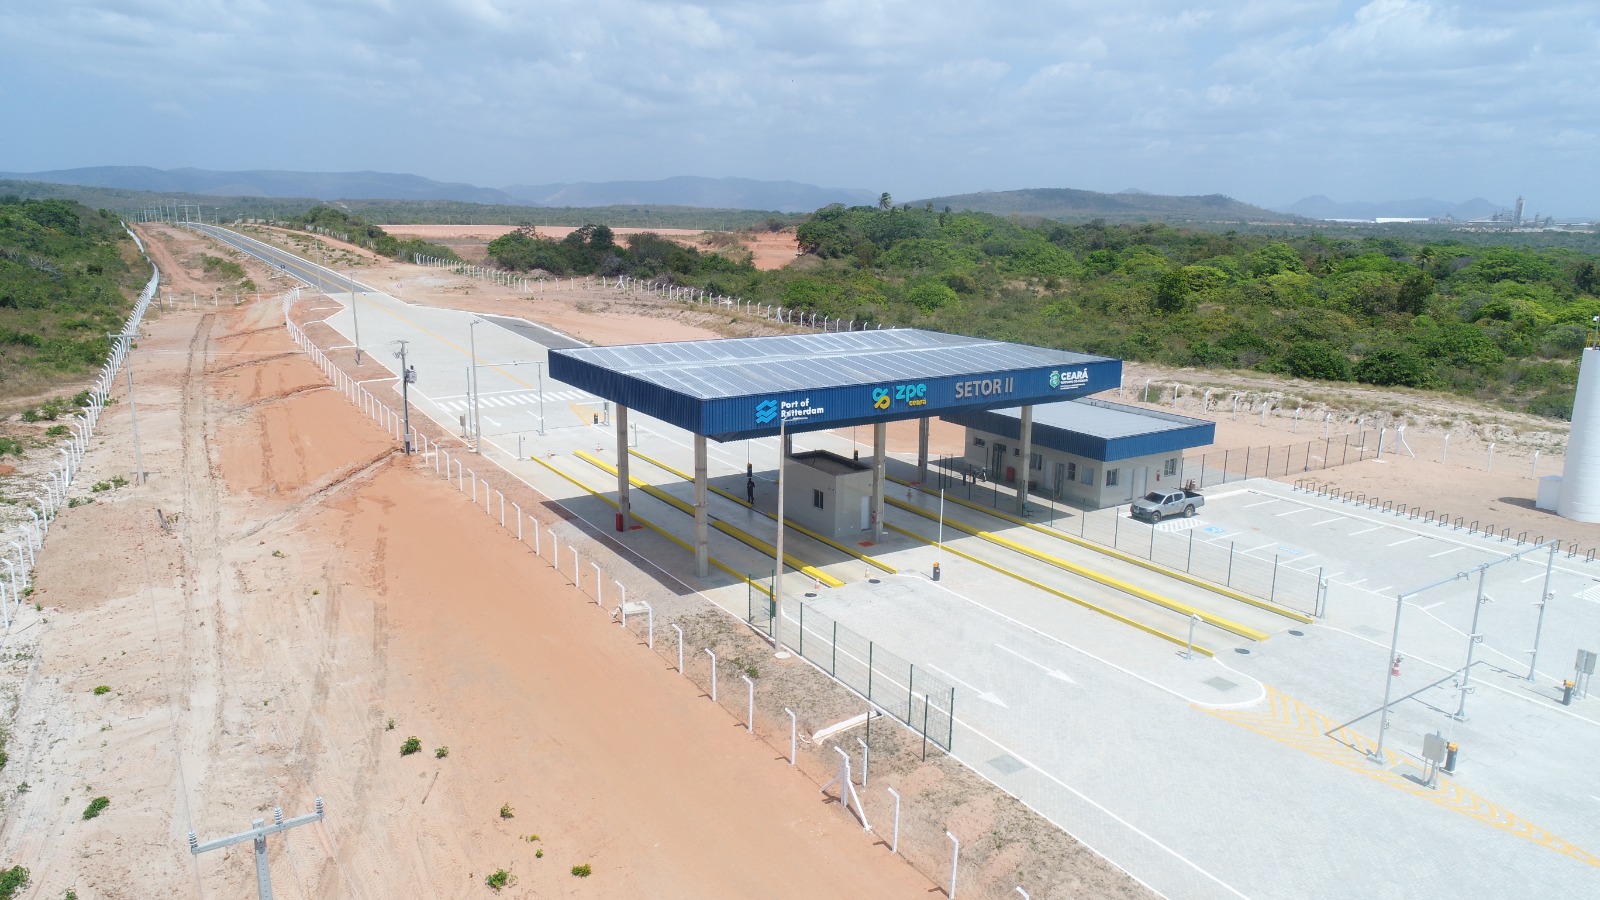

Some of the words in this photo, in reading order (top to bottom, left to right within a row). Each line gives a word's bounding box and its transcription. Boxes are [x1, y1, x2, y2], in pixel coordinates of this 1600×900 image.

[1061, 368, 1088, 380] CEARÁ
[895, 384, 926, 402] zpe
[955, 379, 1001, 398] SETOR
[1005, 377, 1014, 393] II
[781, 401, 798, 409] Port
[800, 398, 809, 406] of
